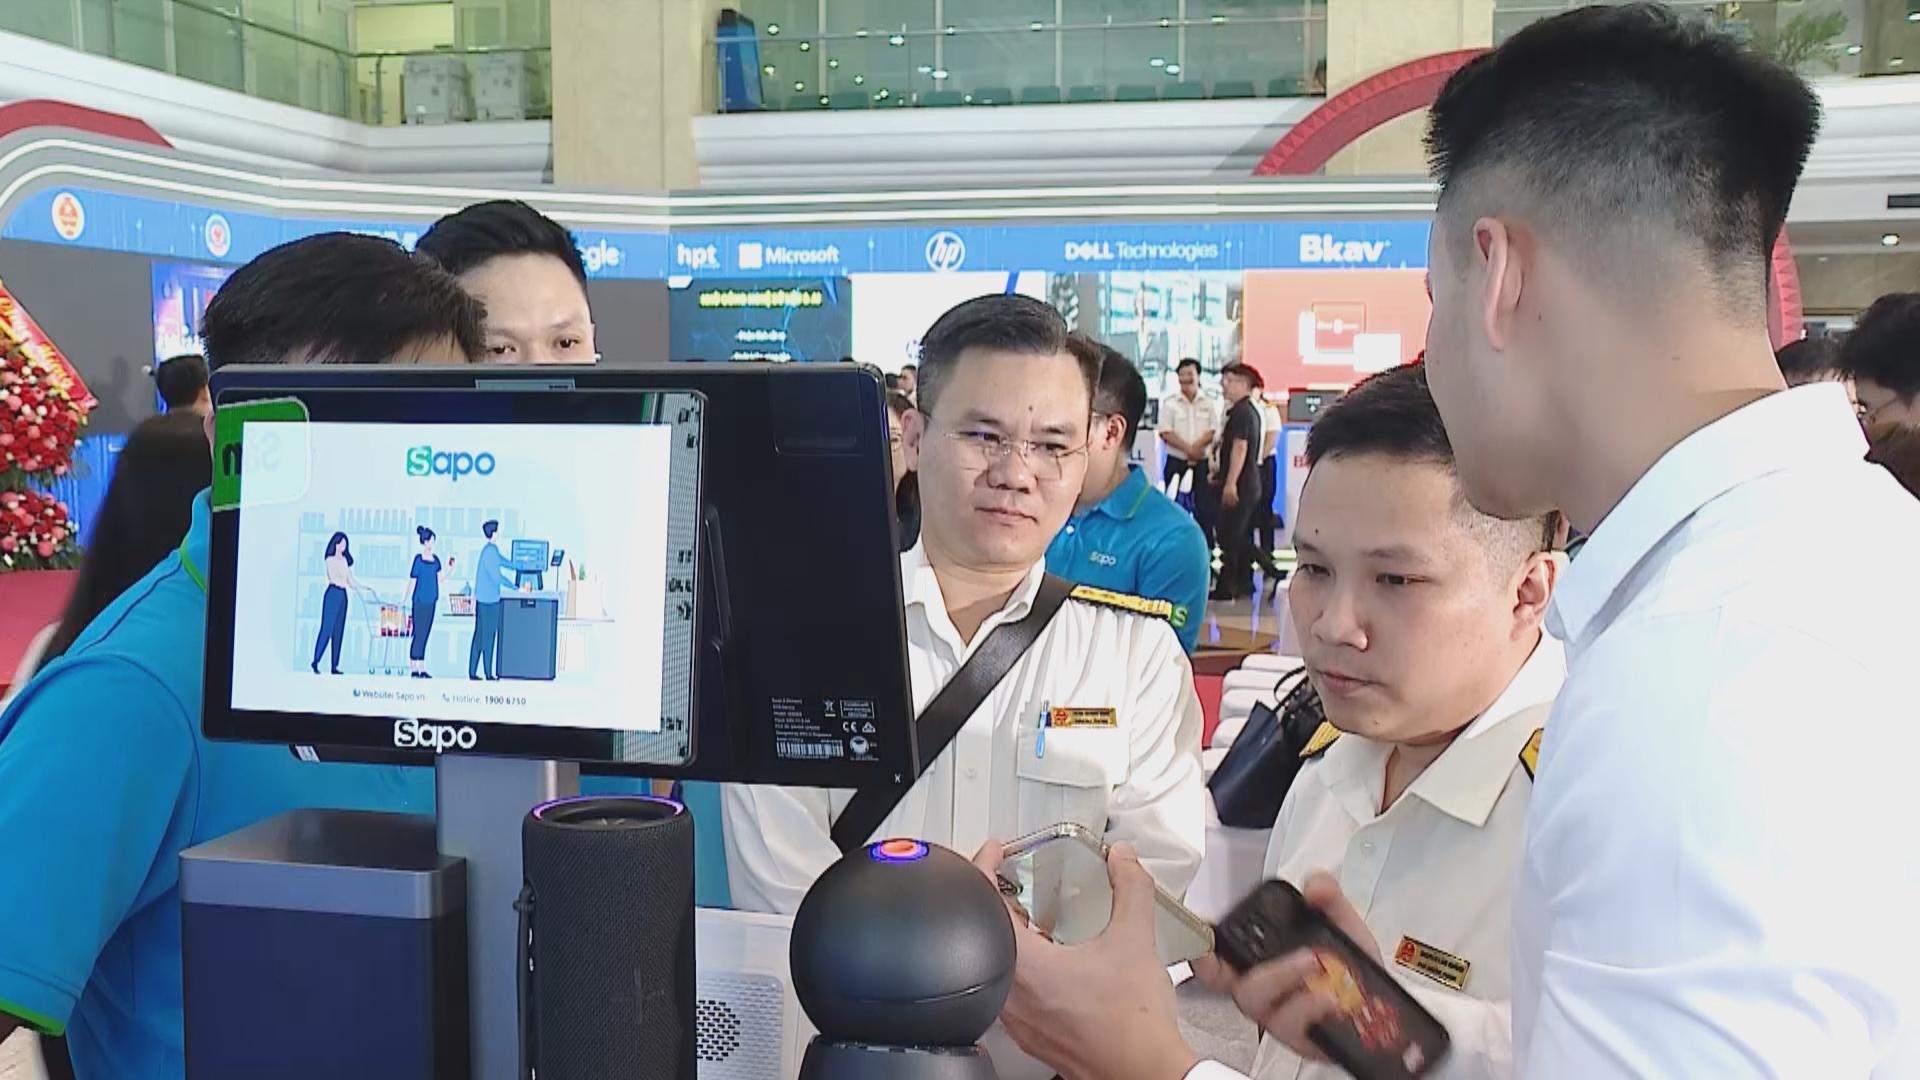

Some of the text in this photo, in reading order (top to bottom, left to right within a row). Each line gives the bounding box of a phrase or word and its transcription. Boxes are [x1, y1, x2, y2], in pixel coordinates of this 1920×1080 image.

[580, 239, 620, 272] gle
[677, 243, 717, 270] hpt
[765, 245, 840, 266] Microsoft
[928, 232, 964, 271] hp
[1064, 240, 1219, 262] DELL Technologies
[1299, 233, 1384, 263] Bkav
[406, 446, 495, 482] Sapo
[485, 695, 504, 705] 1900
[393, 719, 478, 754] Sapo
